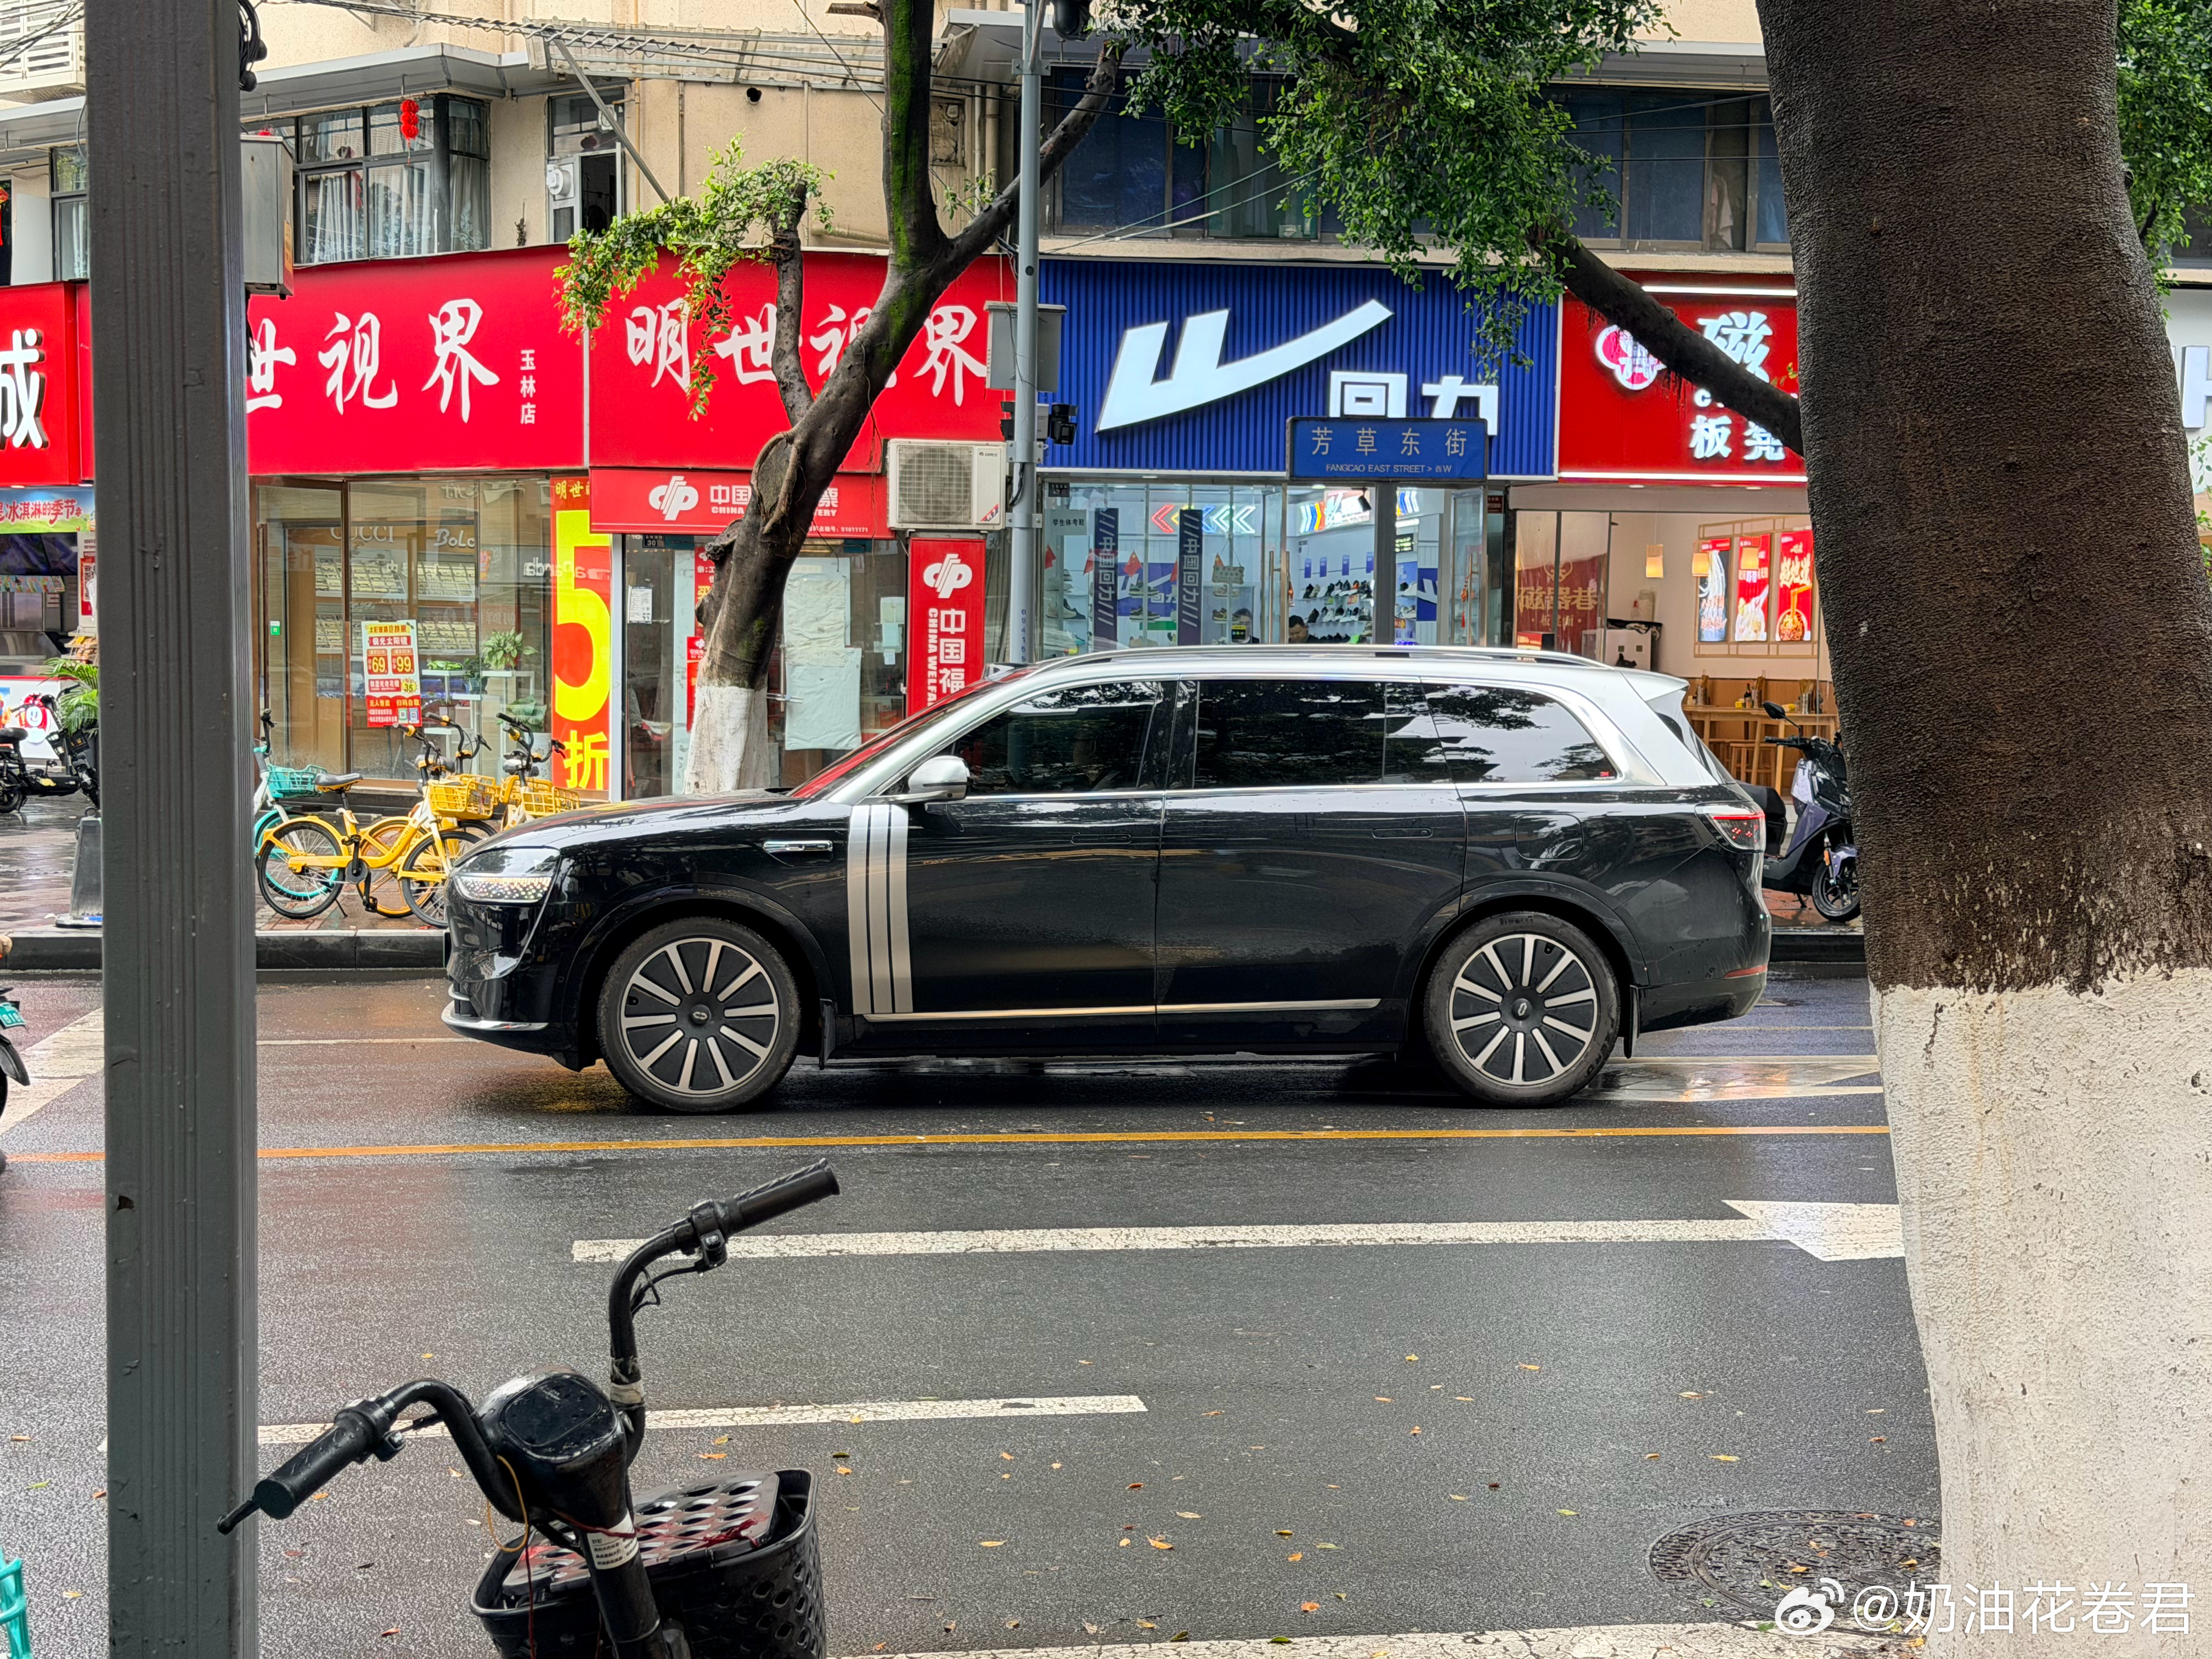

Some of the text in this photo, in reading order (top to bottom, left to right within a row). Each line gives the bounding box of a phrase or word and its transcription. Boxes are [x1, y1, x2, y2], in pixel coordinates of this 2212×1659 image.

[520, 349, 537, 425] 玉林店
[1329, 371, 1499, 436] 回力
[1311, 426, 1467, 457] 芳草东街
[555, 479, 590, 500] 明世
[1325, 464, 1365, 472] FANGCAO
[1368, 464, 1391, 472] EAST
[1393, 465, 1425, 473] STREET
[1098, 537, 1116, 601] 中国回力
[1183, 538, 1200, 603] 中国回力
[928, 607, 938, 654] CHINA
[939, 608, 966, 695] 中国福
[372, 656, 386, 673] 69
[396, 656, 411, 673] 99
